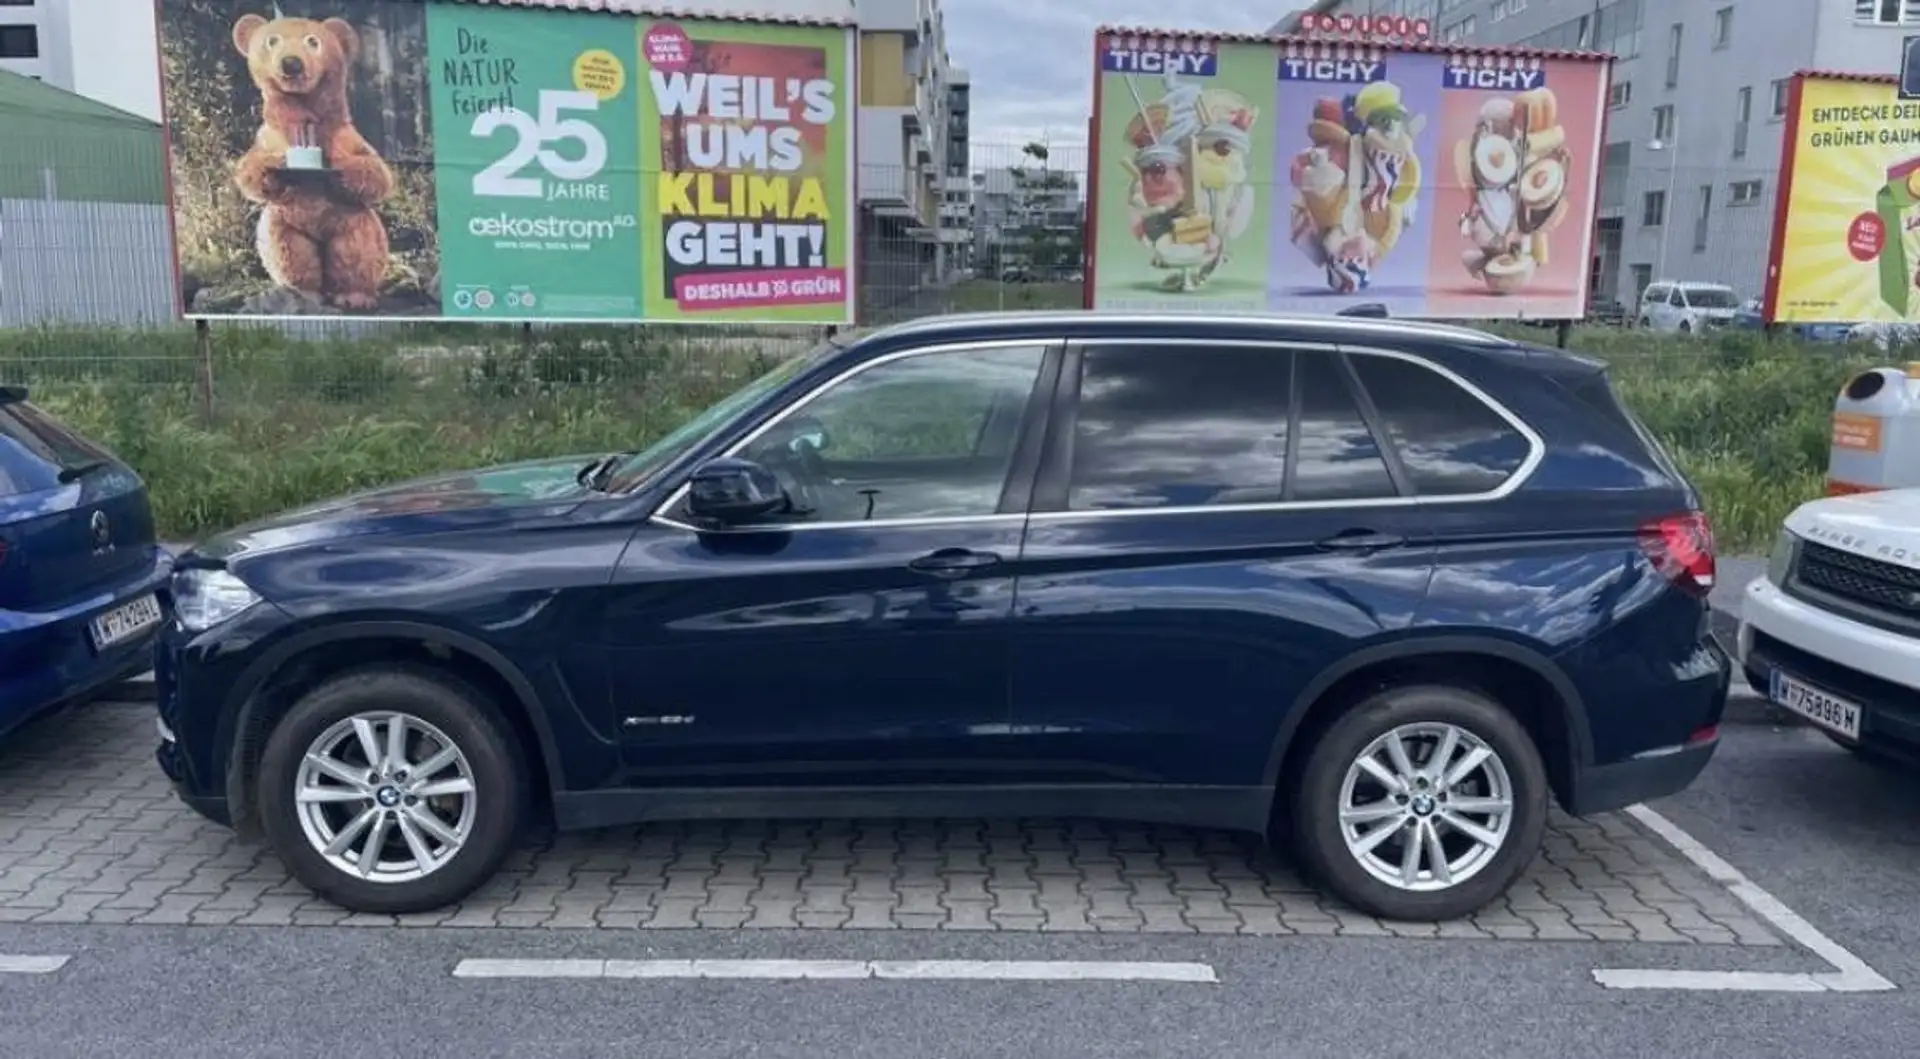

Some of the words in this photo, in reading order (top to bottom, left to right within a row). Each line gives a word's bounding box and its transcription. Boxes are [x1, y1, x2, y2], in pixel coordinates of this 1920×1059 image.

[457, 26, 489, 55] Die
[443, 58, 519, 88] NATUR
[1109, 50, 1208, 74] TICHY
[1286, 59, 1379, 81] TICHY
[1450, 67, 1538, 89] TICHY
[649, 69, 836, 125] WEIL'S
[1811, 104, 1889, 123] ENTDECKE
[470, 89, 608, 197] 25
[686, 123, 803, 171] UMS
[1810, 126, 1875, 148] GRÜNEN
[547, 183, 610, 201] JAHRE
[659, 170, 831, 220] KLIMA
[665, 220, 824, 267] GEHT!
[684, 281, 770, 300] DESHALB
[790, 275, 841, 296] GRÜN
